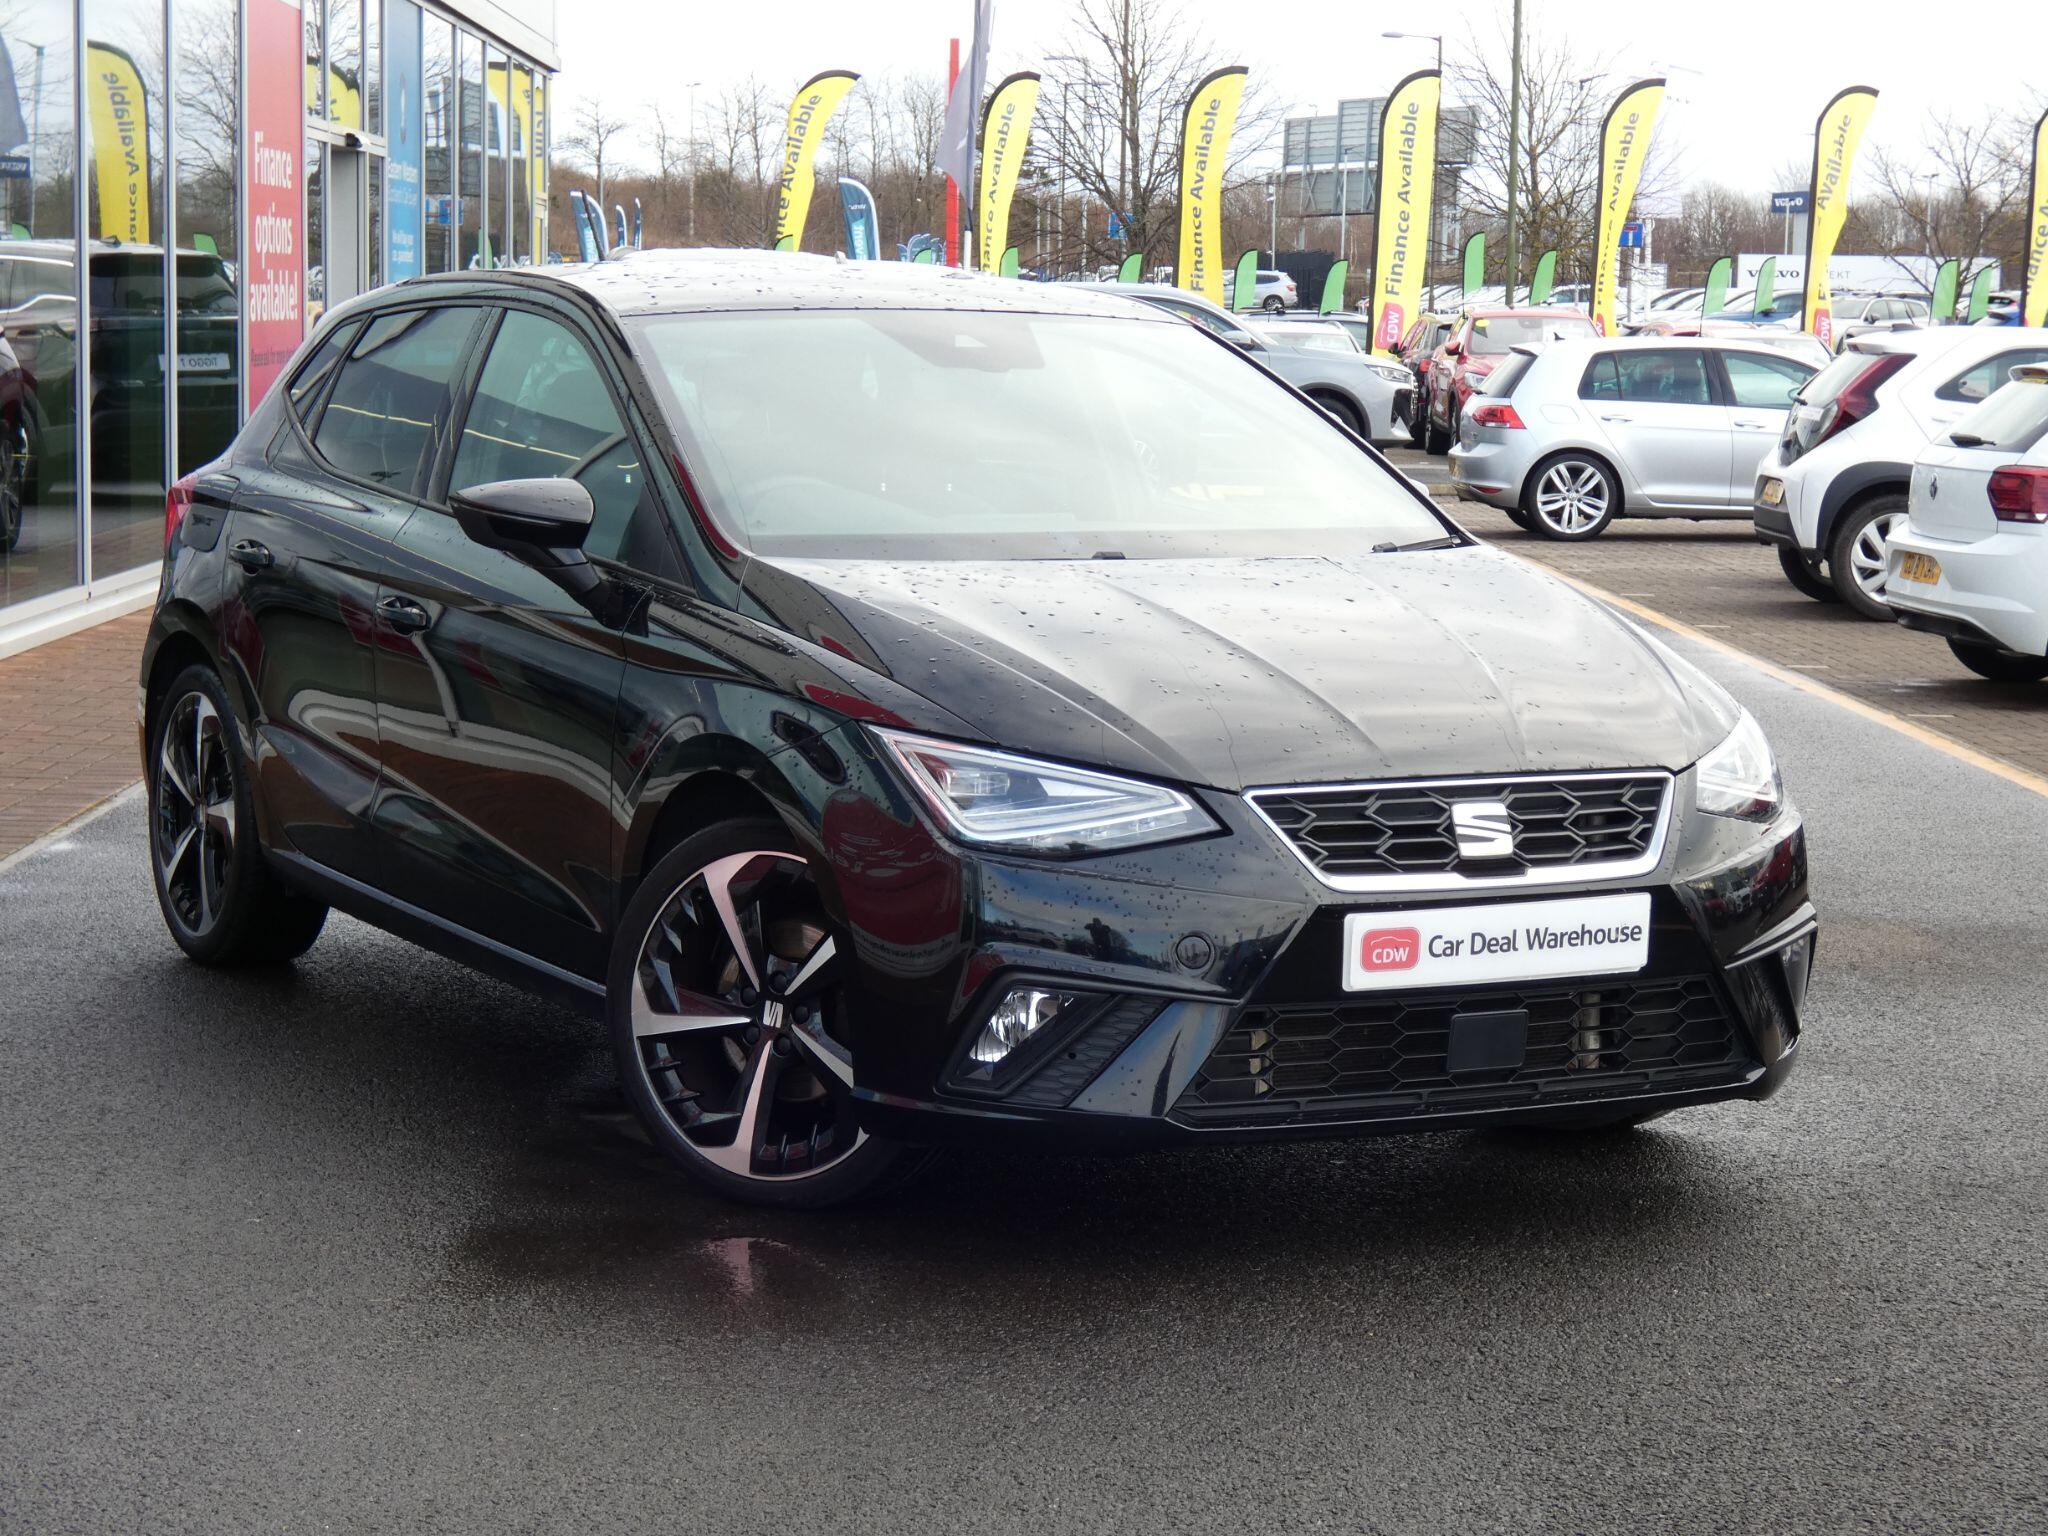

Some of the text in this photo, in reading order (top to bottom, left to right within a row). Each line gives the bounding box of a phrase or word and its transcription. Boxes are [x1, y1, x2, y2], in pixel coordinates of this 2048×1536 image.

[255, 131, 293, 190] Finance
[783, 94, 822, 192] Available
[988, 102, 1016, 203] Available
[1609, 111, 1640, 212] Available
[1817, 113, 1853, 210] Available
[1190, 98, 1221, 292] Finance Available
[1385, 101, 1420, 296] Finance Available
[255, 201, 293, 270] options
[250, 268, 298, 322] available!
[1747, 268, 1800, 279] VVO
[1386, 310, 1399, 342] CDW
[1372, 946, 1410, 964] CDW
[1428, 923, 1642, 959] Car Deal Warehouse
